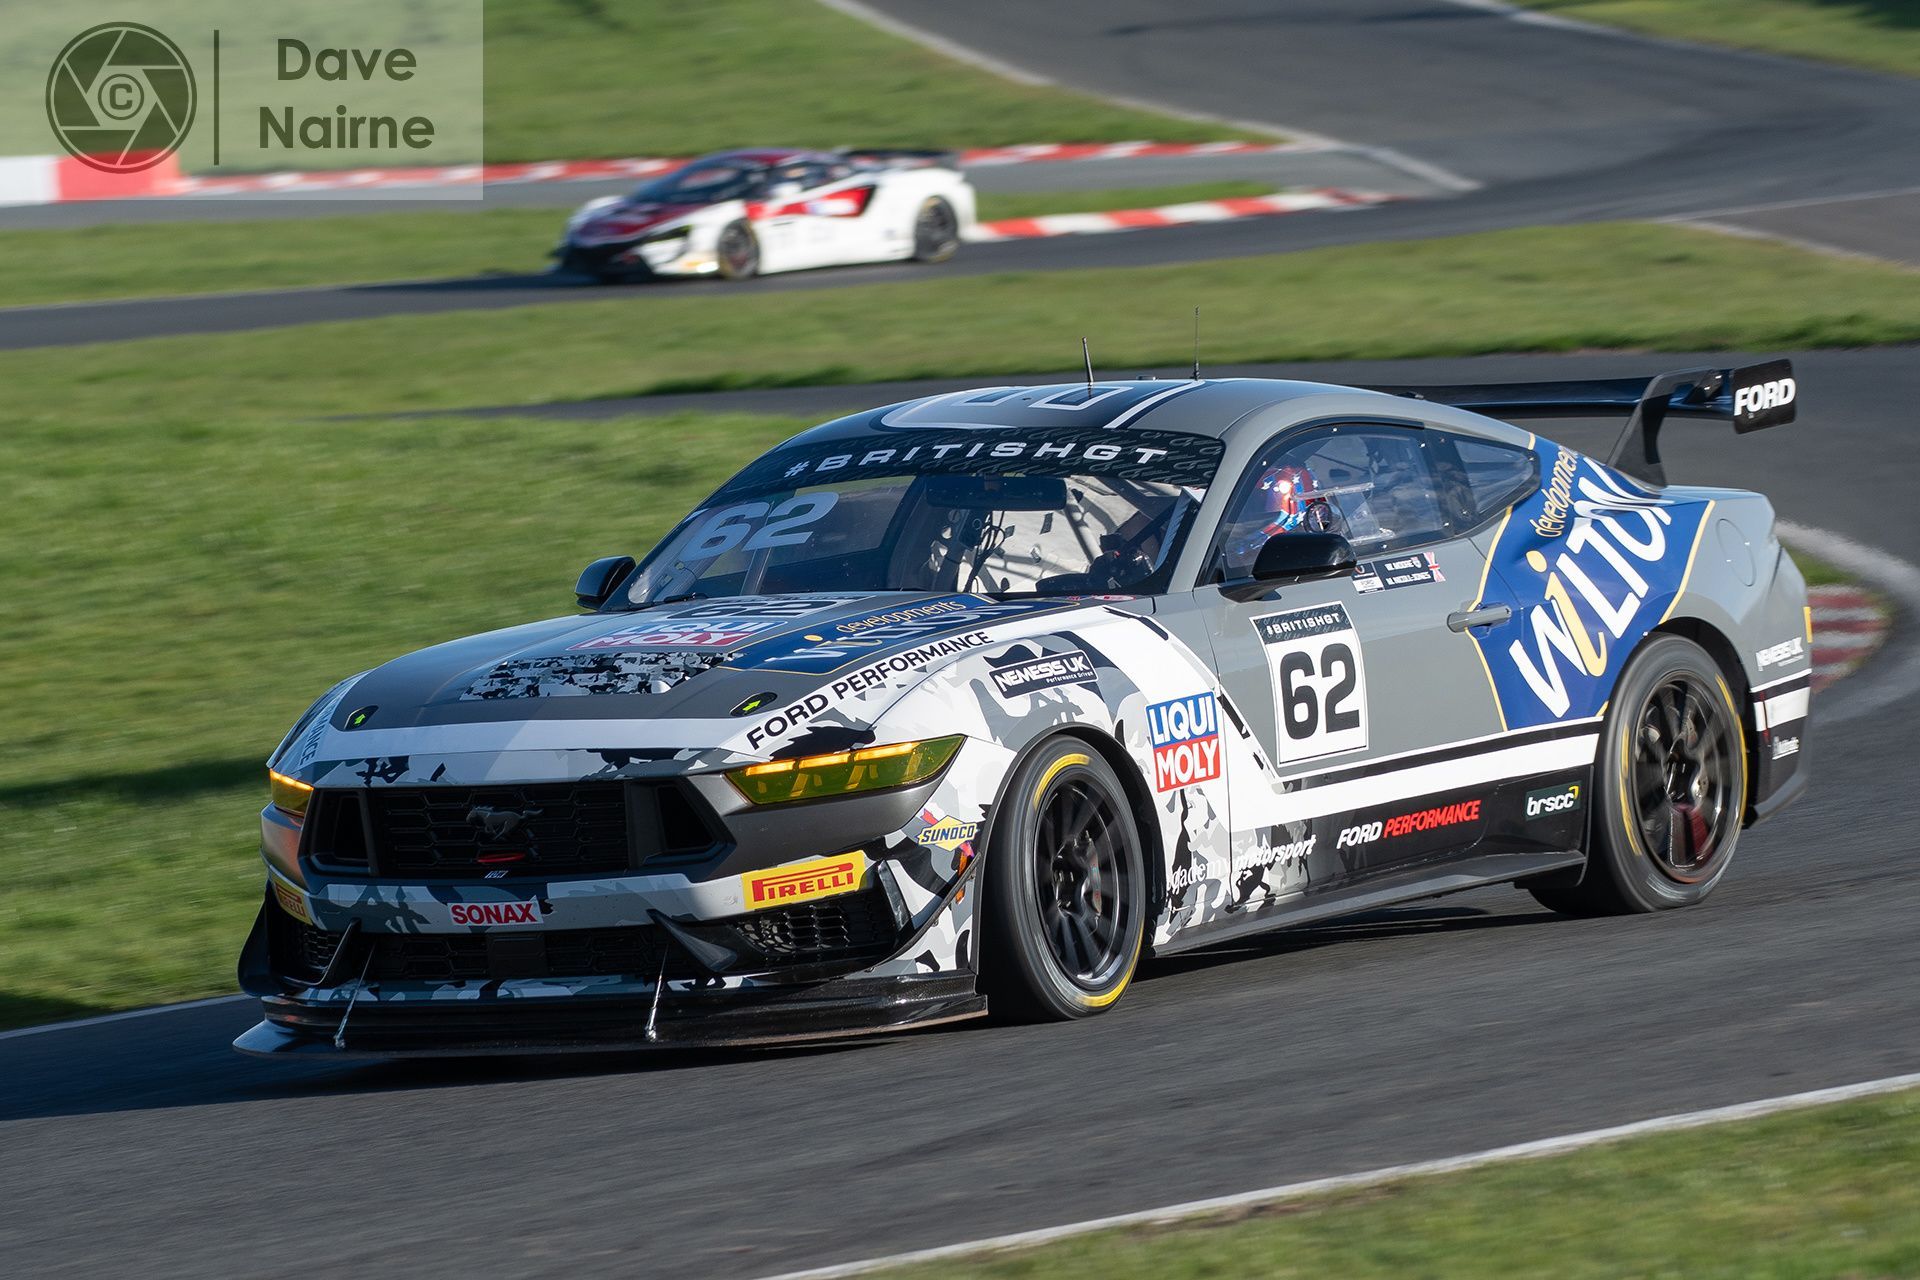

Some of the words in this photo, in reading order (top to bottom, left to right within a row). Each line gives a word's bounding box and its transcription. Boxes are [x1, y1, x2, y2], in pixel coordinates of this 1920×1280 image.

[1733, 378, 1796, 416] FORD
[783, 441, 1168, 479] #BRITISHGT
[679, 491, 840, 562] 62
[836, 600, 967, 634] developments
[1266, 612, 1341, 636] #BRITISHGT
[580, 632, 748, 648] MOLY
[746, 693, 829, 750] FORD
[831, 631, 995, 700] PERFORMANCE
[994, 659, 1067, 692] NEMESIS
[1062, 655, 1091, 673] UK
[1279, 642, 1361, 740] 62
[1148, 695, 1216, 745] LIQUI
[1156, 738, 1219, 790] MOLY
[1526, 791, 1576, 816] brscc
[922, 825, 978, 843] SUNOCO
[1336, 821, 1383, 850] FORD
[1383, 799, 1482, 839] PERFORMANCE
[751, 861, 854, 903] PIRELLI
[451, 903, 538, 925] SONAX
